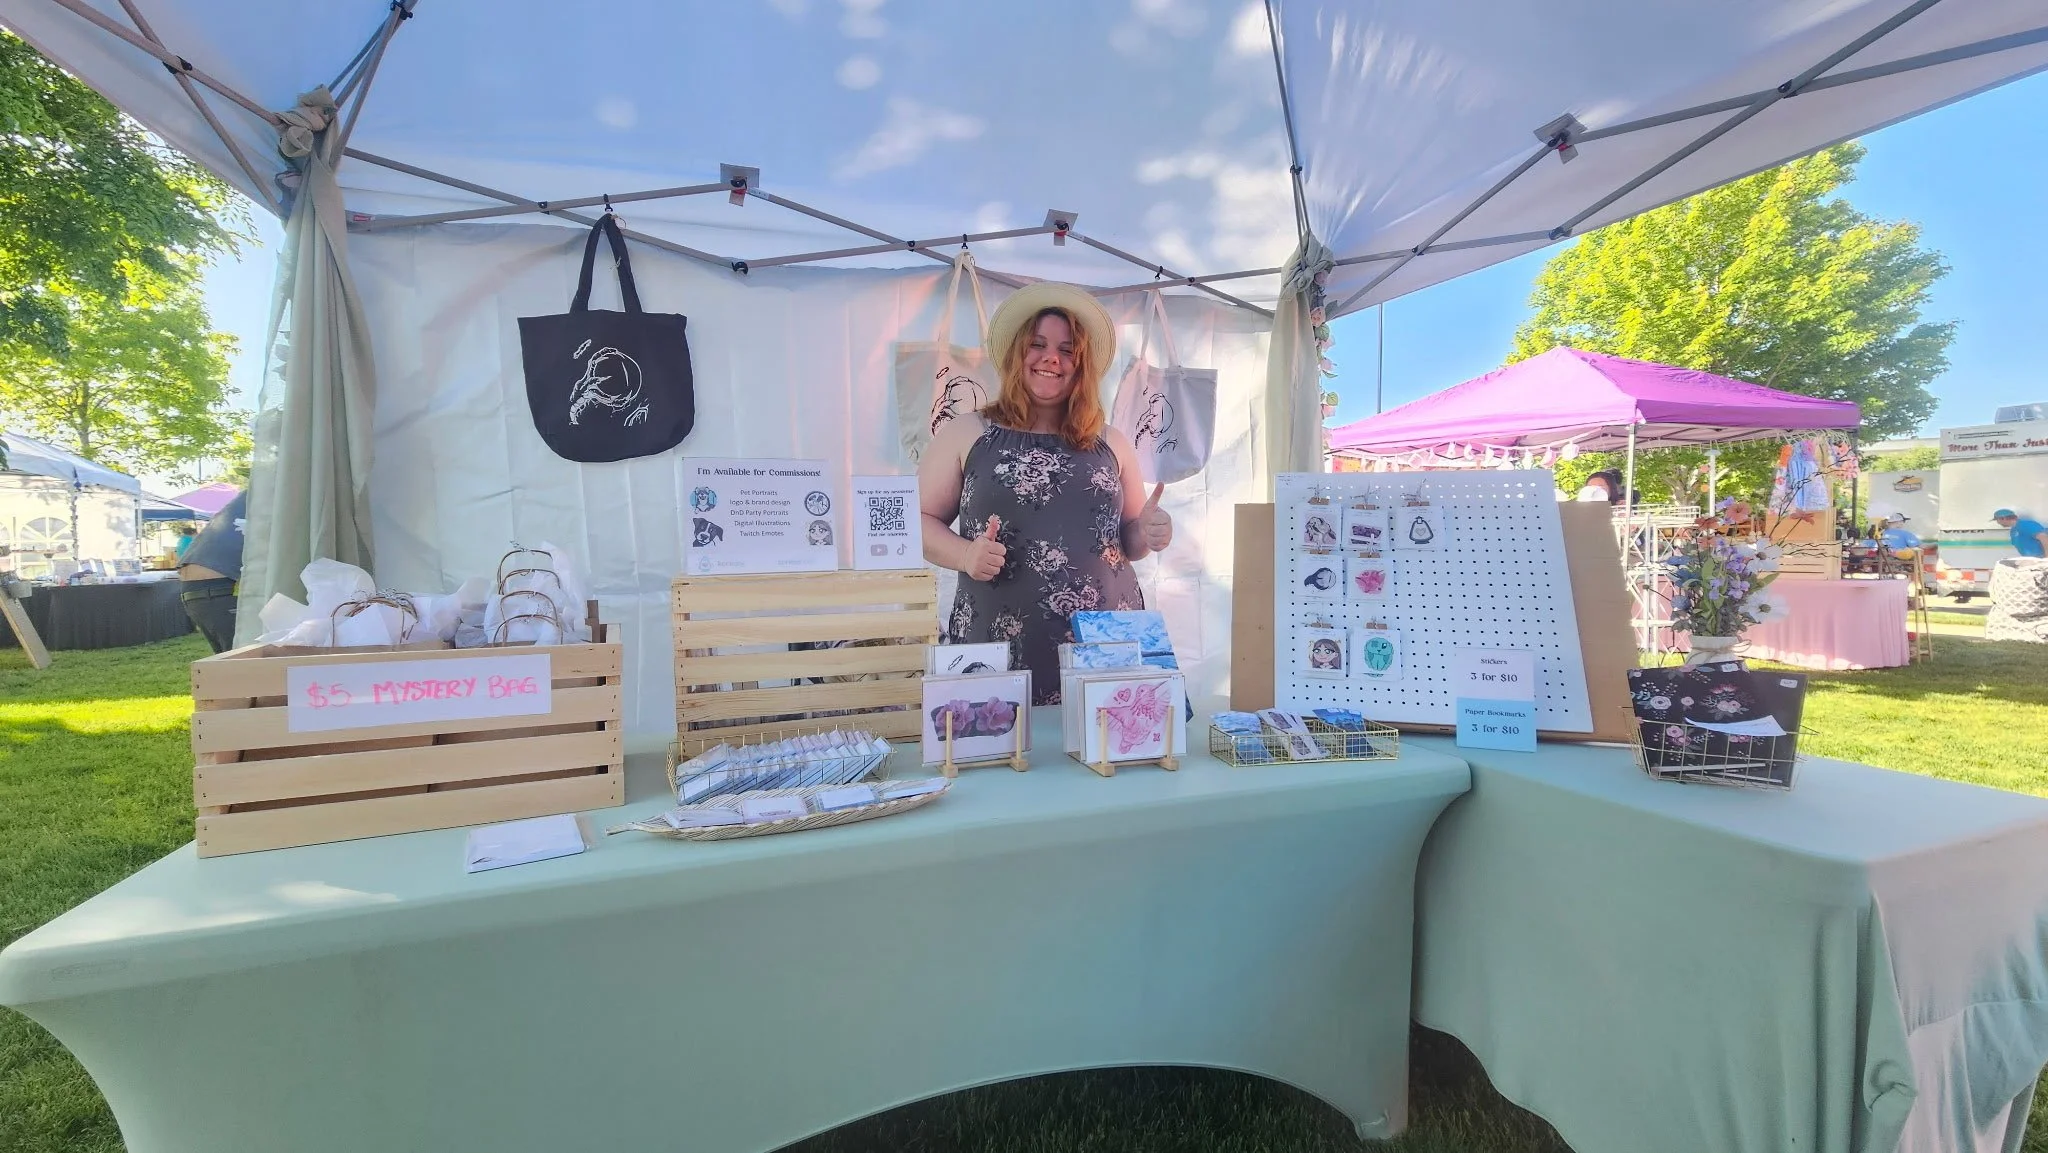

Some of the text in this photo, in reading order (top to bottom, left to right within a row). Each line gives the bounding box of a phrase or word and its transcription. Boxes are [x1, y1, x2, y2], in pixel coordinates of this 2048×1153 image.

[1948, 444, 1979, 452] More
[1984, 440, 2019, 451] Than
[697, 467, 821, 476] I'm Available for Commissions!
[1471, 672, 1518, 682] 3 for $10
[306, 675, 538, 710] $5 MYSTERY BAG
[1487, 710, 1526, 718] Bookmarks
[1472, 724, 1520, 735] 3 for $10
